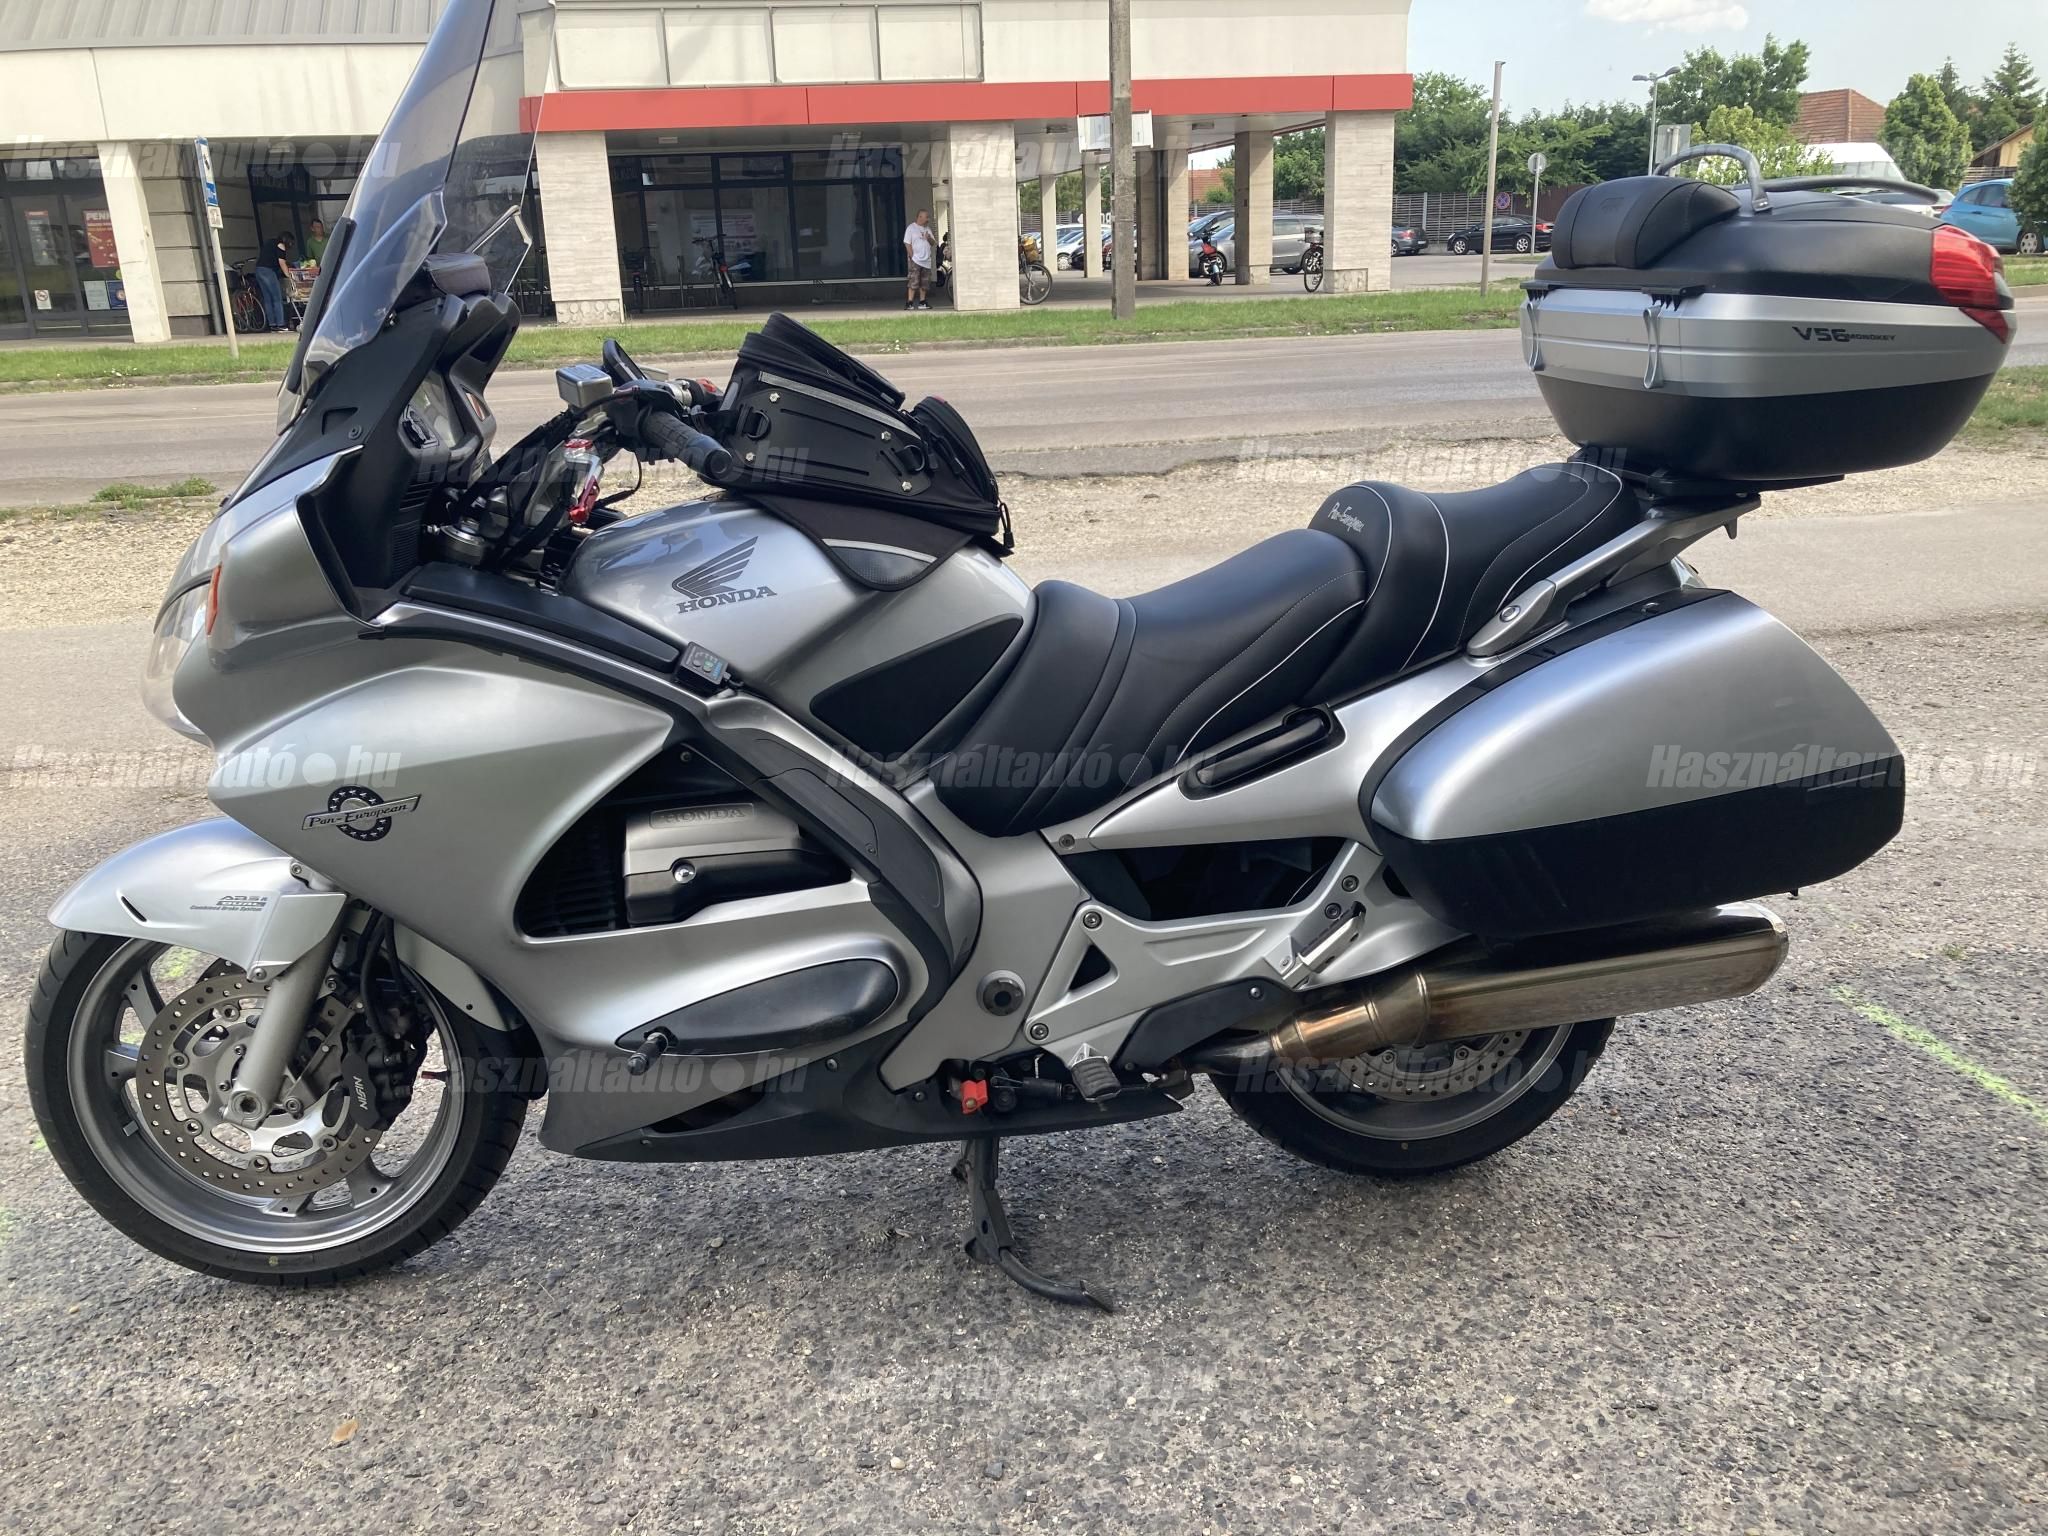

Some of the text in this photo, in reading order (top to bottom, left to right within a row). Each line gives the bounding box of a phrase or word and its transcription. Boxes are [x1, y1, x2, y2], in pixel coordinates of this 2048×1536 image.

[1792, 326, 1850, 342] V56
[677, 586, 777, 613] HONDA
[309, 804, 408, 828] Pan-European
[664, 808, 746, 823] HONDA
